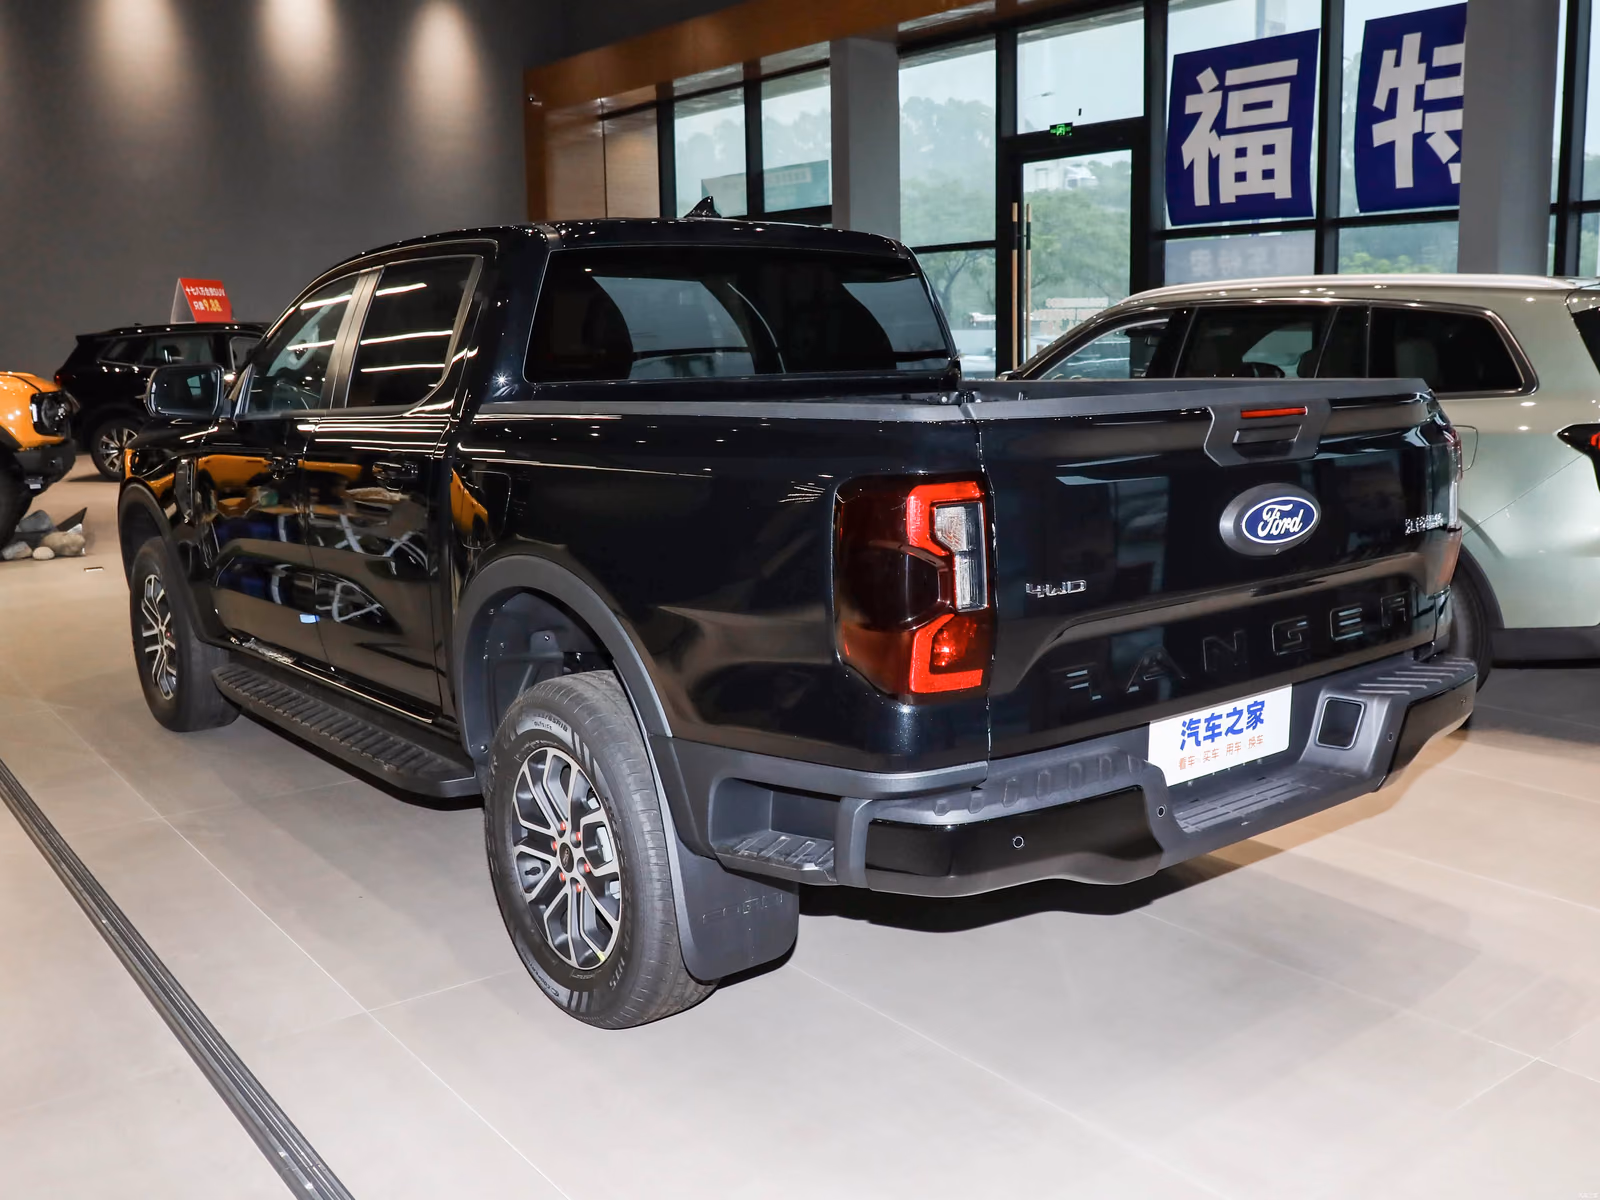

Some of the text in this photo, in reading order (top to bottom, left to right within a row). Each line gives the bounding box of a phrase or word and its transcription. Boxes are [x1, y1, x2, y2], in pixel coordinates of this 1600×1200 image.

[1181, 57, 1299, 207] 福
[1257, 503, 1304, 537] Ford
[1026, 580, 1087, 599] 4WD
[1049, 592, 1407, 701] RANGER
[1180, 700, 1265, 751] 汽车之家
[1203, 748, 1219, 763] 买车
[1226, 741, 1241, 756] 用车
